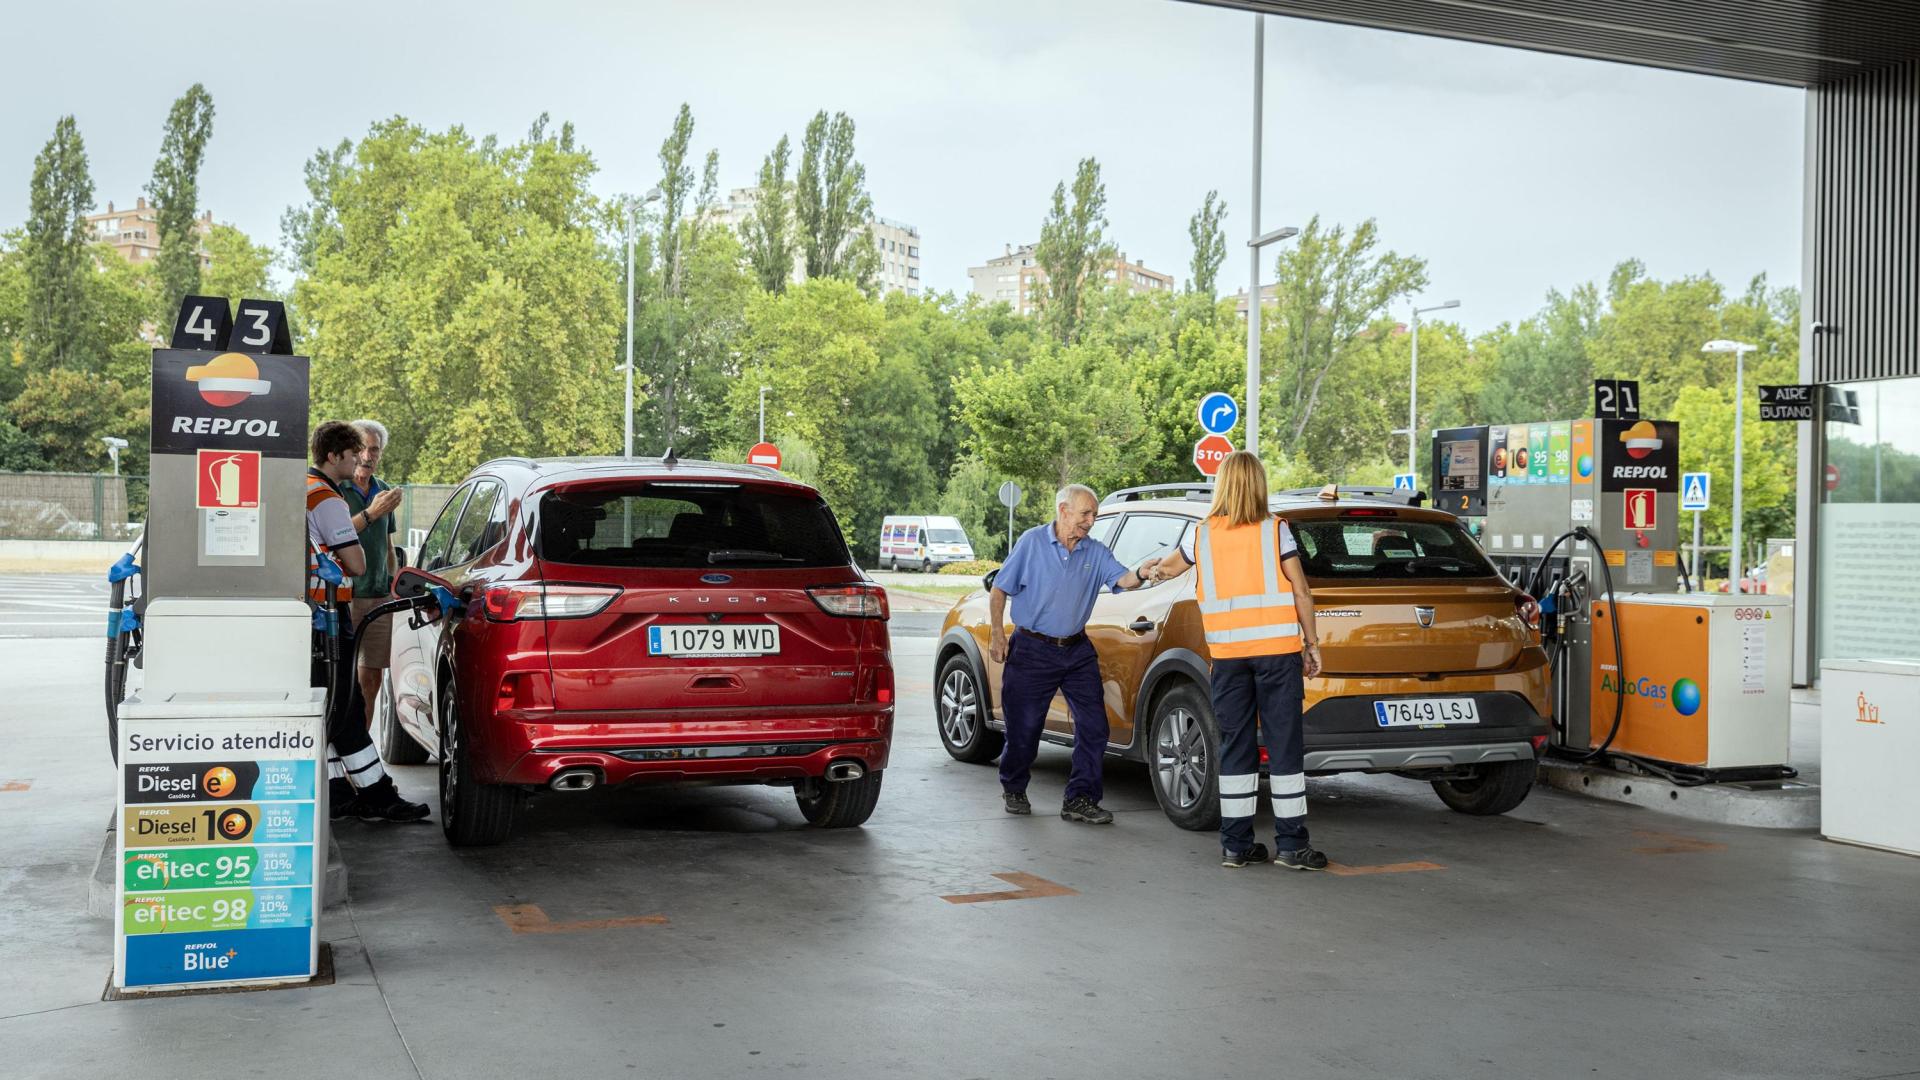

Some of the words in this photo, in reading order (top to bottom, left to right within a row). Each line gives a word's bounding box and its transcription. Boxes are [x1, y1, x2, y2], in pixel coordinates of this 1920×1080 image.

[184, 305, 217, 342] 4
[241, 309, 271, 346] 3
[1598, 386, 1616, 411] 2
[1621, 387, 1637, 412] 1
[1775, 387, 1807, 400] AIRE
[1761, 406, 1812, 418] BUTANO
[171, 416, 281, 438] REPSOL
[1534, 451, 1547, 464] 95
[1555, 450, 1569, 462] 98
[1612, 466, 1668, 479] REPSOL
[1461, 495, 1469, 510] 2
[670, 630, 725, 651] 1079
[733, 629, 775, 650] MVD
[1388, 703, 1435, 722] 7649
[1439, 702, 1473, 720] LSJ
[129, 733, 214, 752] Servicio
[222, 731, 314, 750] atendido
[138, 773, 196, 792] Diesel
[265, 773, 293, 785] 10%
[138, 817, 196, 835] Diesel
[267, 816, 295, 827] 10%
[137, 861, 210, 880] efitec
[215, 856, 251, 879] 95
[264, 859, 292, 870] 10%
[134, 904, 207, 924] efitec
[212, 898, 247, 922] 98
[260, 901, 288, 912] 10%
